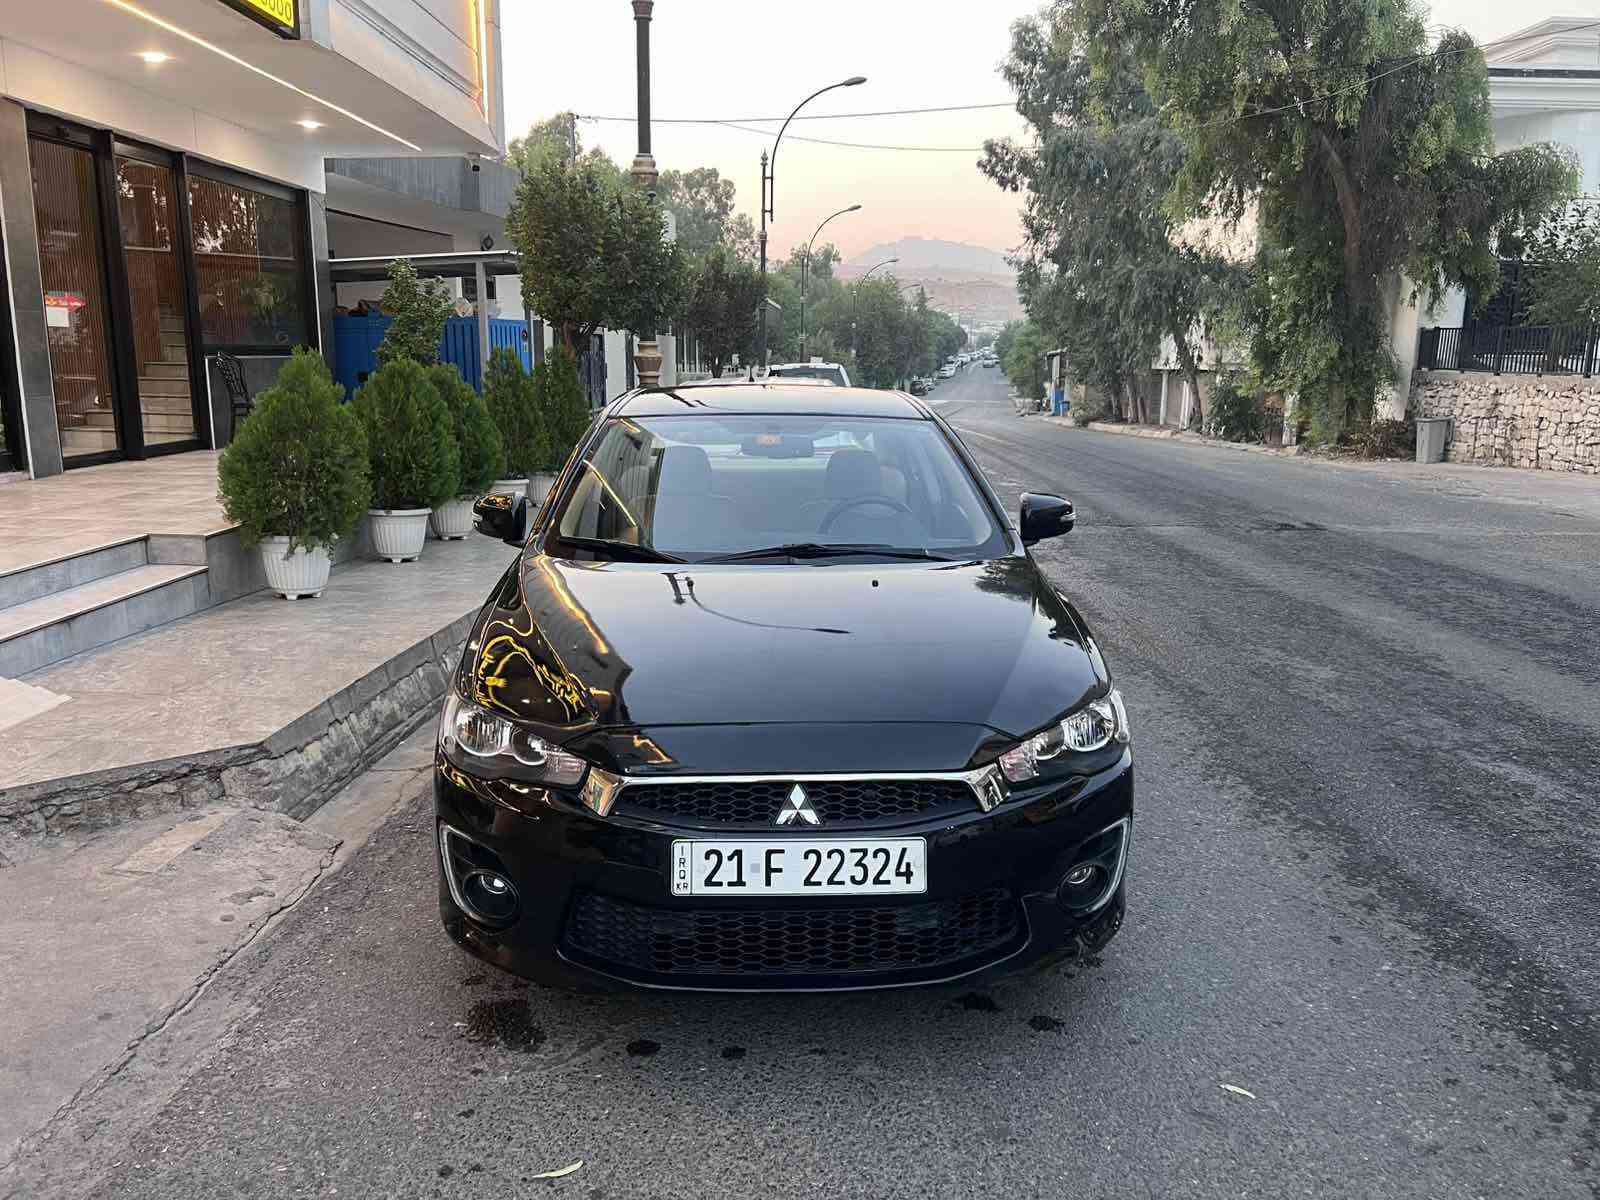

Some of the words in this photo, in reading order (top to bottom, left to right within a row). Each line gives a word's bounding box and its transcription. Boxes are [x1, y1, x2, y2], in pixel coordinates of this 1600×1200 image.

[704, 849, 747, 887] 21
[764, 849, 786, 887] F
[803, 847, 914, 887] 22324
